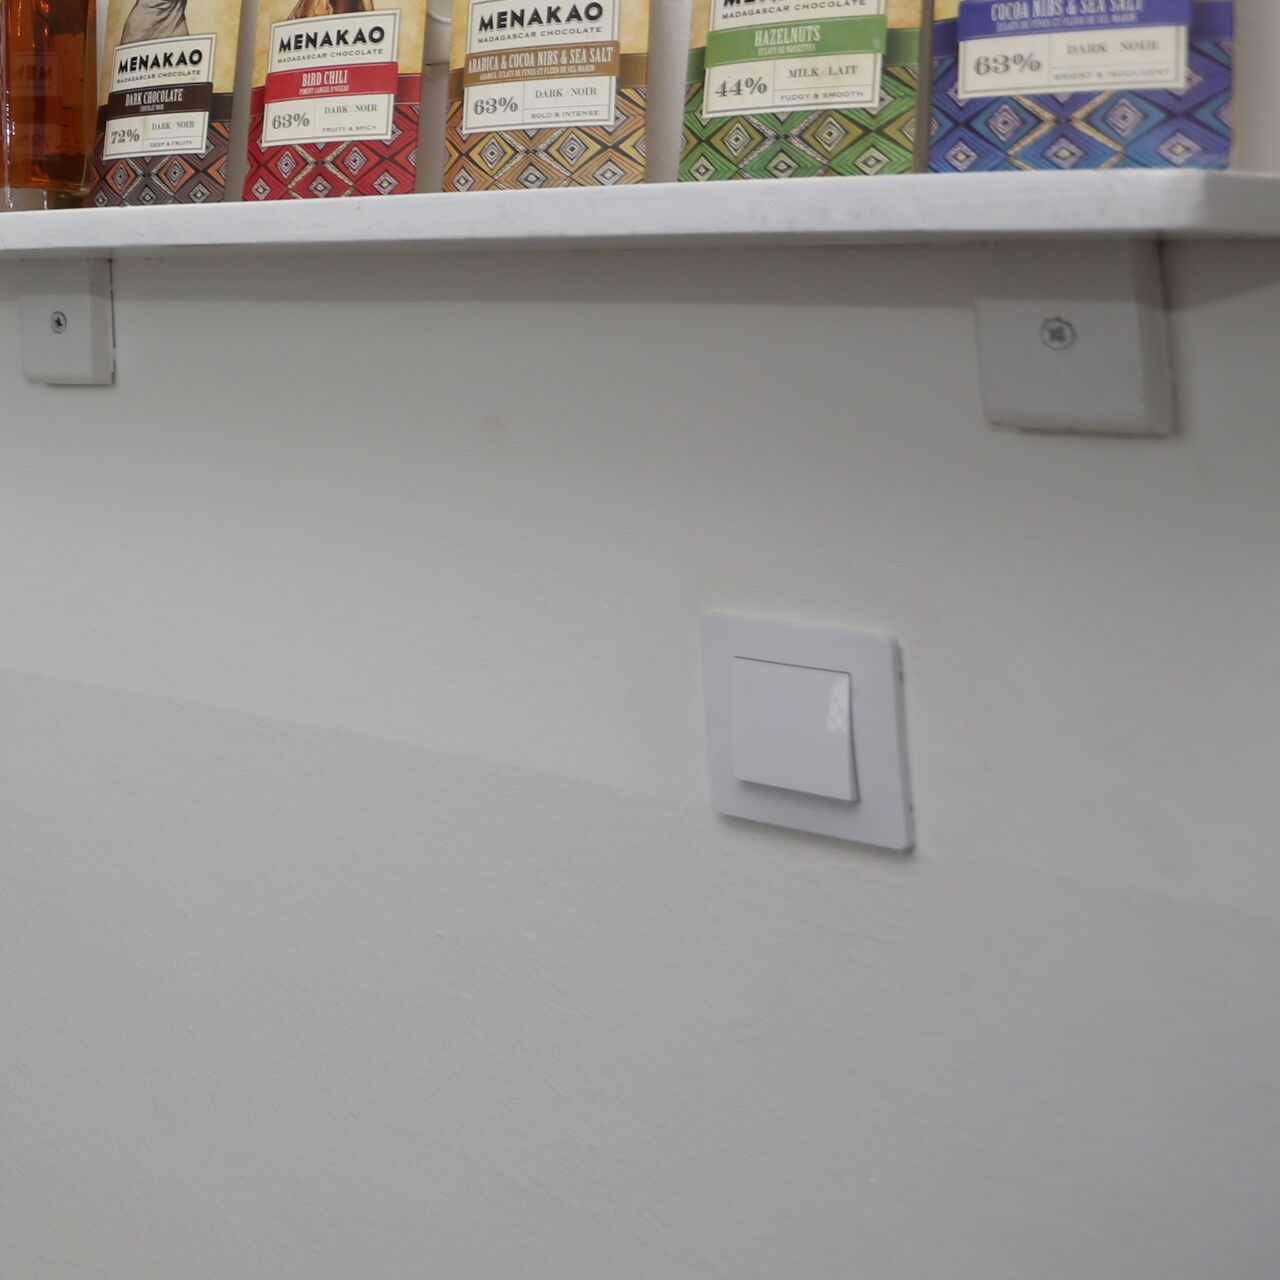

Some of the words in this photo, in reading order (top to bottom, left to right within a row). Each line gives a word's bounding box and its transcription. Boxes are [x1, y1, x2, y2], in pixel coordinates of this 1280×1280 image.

[478, 2, 603, 32] MENAKAO
[722, 6, 790, 19] MADAGASCAR
[794, 0, 867, 11] CHOCOLATE
[991, 1, 1030, 21] COCOA
[278, 26, 386, 53] MENAKAO
[477, 32, 536, 44] MADAGASCAR
[540, 26, 602, 37] CHOCOLATE
[755, 25, 821, 47] HAZELNUTS
[277, 53, 328, 64] MADAGASCAR
[330, 48, 384, 58] CHOCOLATE
[1067, 43, 1107, 55] DARK
[1120, 40, 1158, 51] NOIR
[118, 49, 203, 74] MENAKAO
[468, 55, 499, 73] ARABICA
[501, 55, 507, 69] &
[509, 53, 535, 68] COCOA
[537, 50, 558, 66] NIBS
[560, 50, 568, 64] &
[570, 49, 586, 63] SEA
[590, 47, 614, 62] SALT
[974, 52, 1041, 75] 63%
[117, 73, 155, 83] MADAGASCAR
[157, 70, 201, 79] CHOCOLATE
[302, 71, 322, 87] BIRD
[323, 70, 348, 85] CHILI
[788, 67, 819, 78] MILK
[828, 65, 858, 76] LAIT
[535, 89, 563, 99] DARK
[571, 87, 597, 96] NOIR
[715, 77, 767, 97] 44%
[125, 93, 142, 106] DARK
[143, 88, 184, 104] CHOCOLATE
[474, 96, 519, 115] 63%
[324, 106, 348, 115] DARK
[353, 104, 378, 113] NOIR
[151, 121, 171, 130] DARK
[176, 120, 195, 129] NOIR
[271, 113, 310, 130] 63%
[111, 128, 140, 144] 72%
[172, 139, 192, 147] FRUITY
